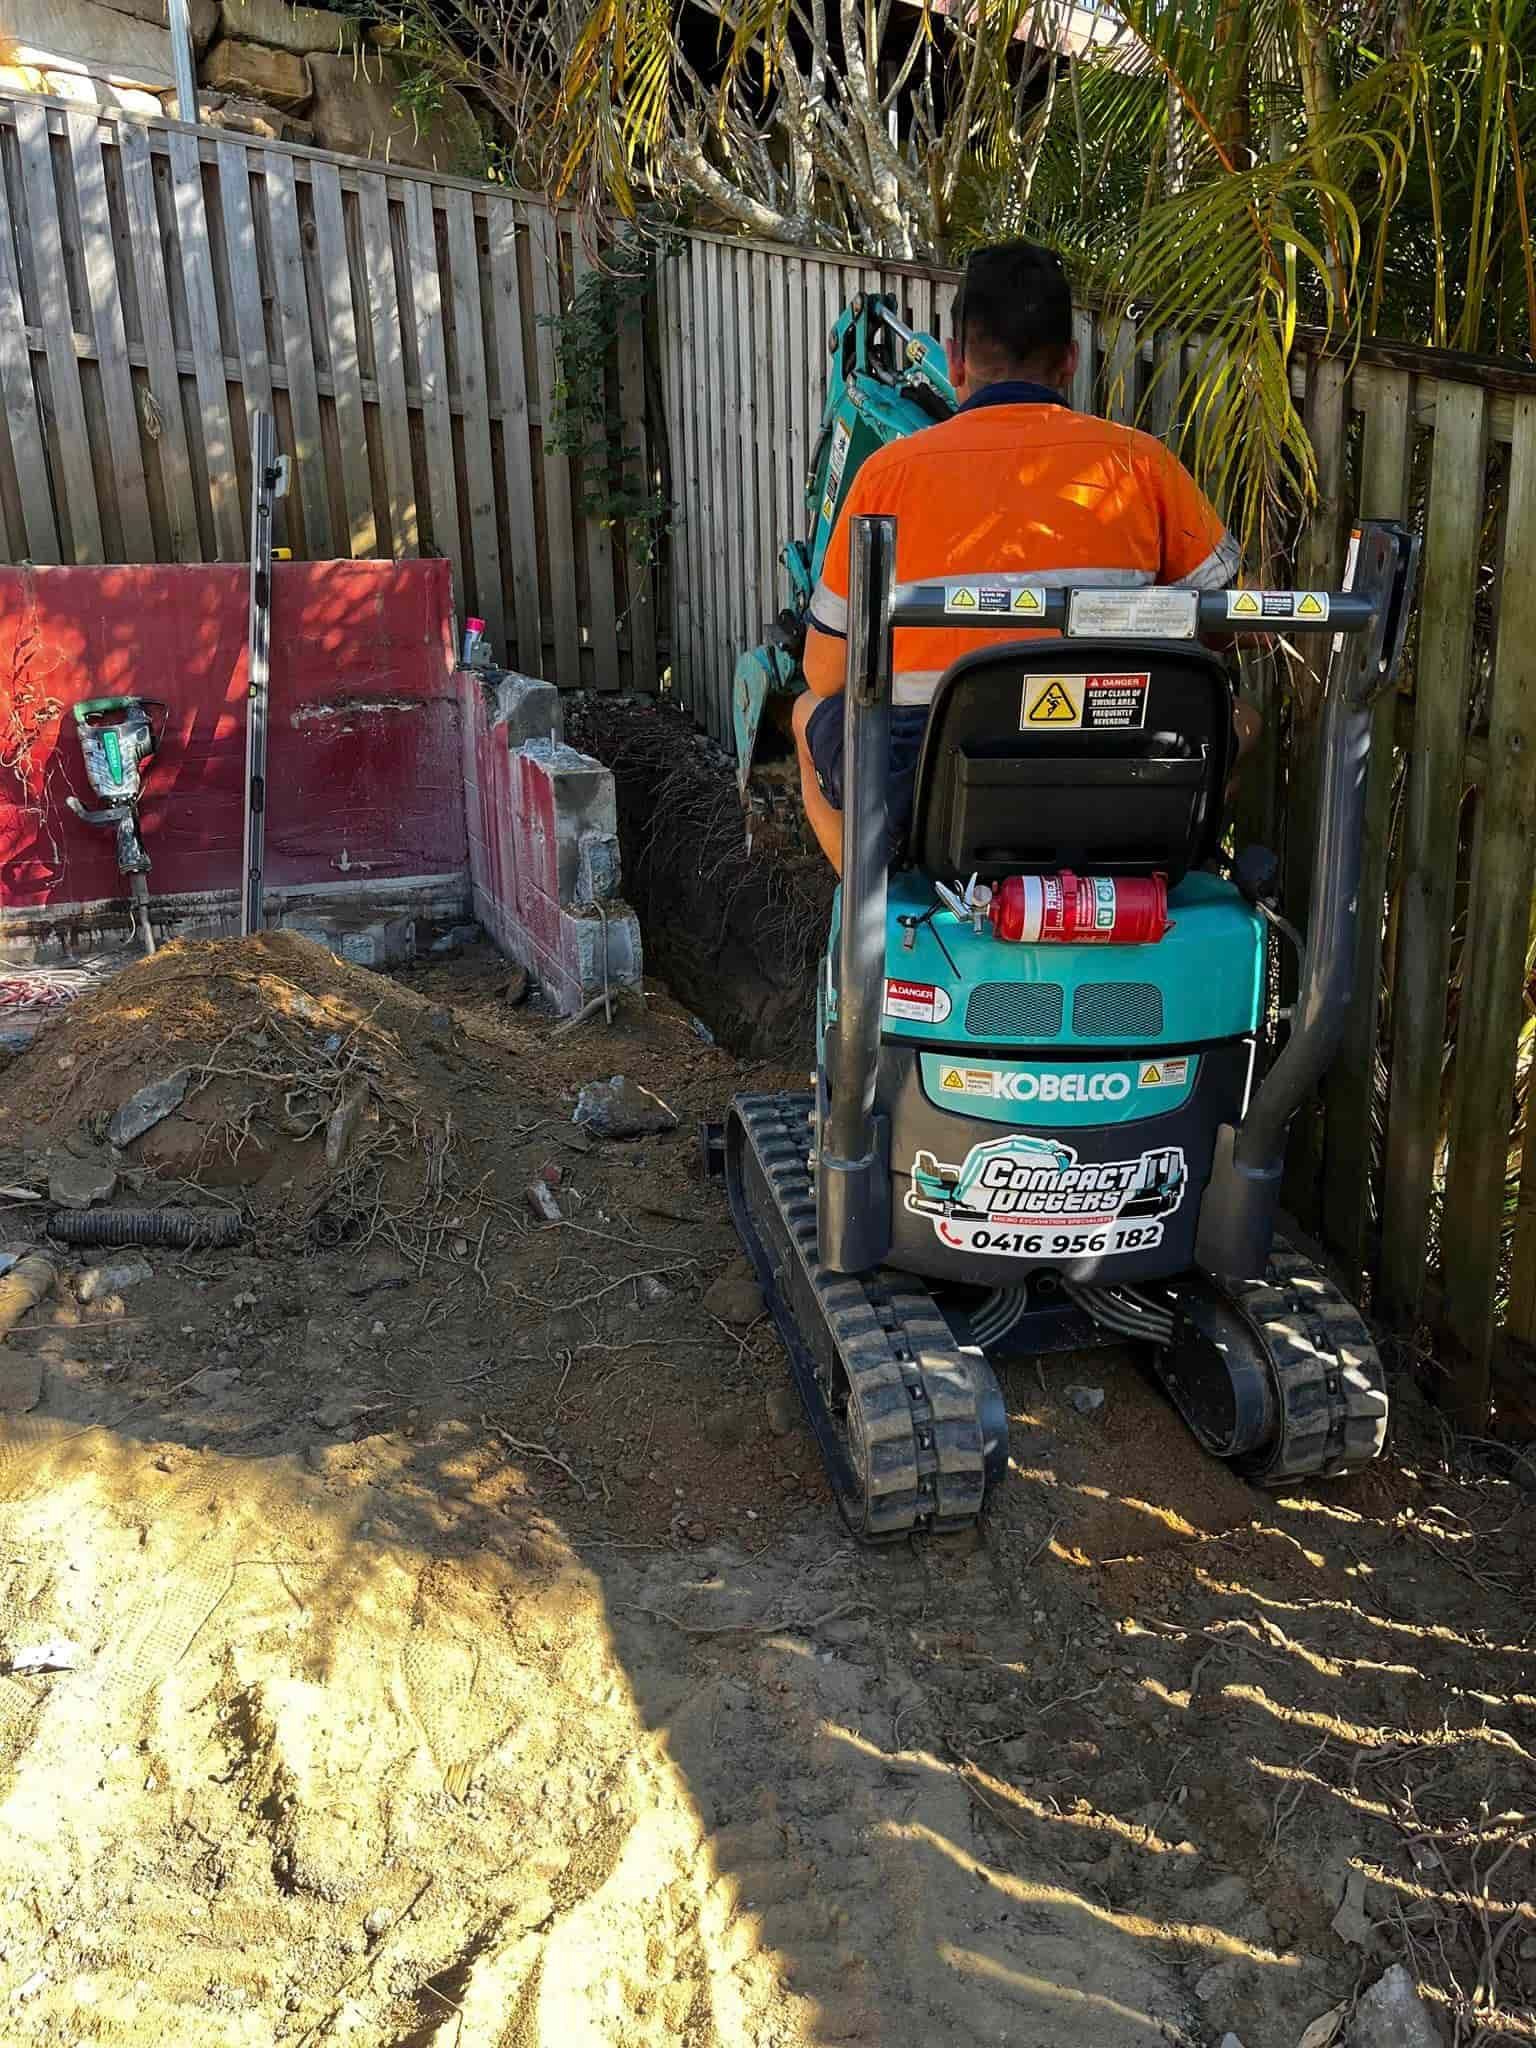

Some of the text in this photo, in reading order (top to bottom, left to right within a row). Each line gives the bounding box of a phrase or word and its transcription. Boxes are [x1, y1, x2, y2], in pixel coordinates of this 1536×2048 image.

[1102, 679, 1140, 687] DANGER
[1117, 698, 1137, 706] AREA
[1092, 709, 1133, 718] FREQUENTLY
[1093, 718, 1130, 726] REVERSING
[898, 986, 933, 999] DANGER
[992, 1072, 1131, 1102] KOBELCO
[982, 1158, 1137, 1191] COMPACT
[988, 1190, 1123, 1213] DIGGERS
[993, 1215, 1018, 1223] MICRO
[972, 1226, 1160, 1253] 0416 956 182
